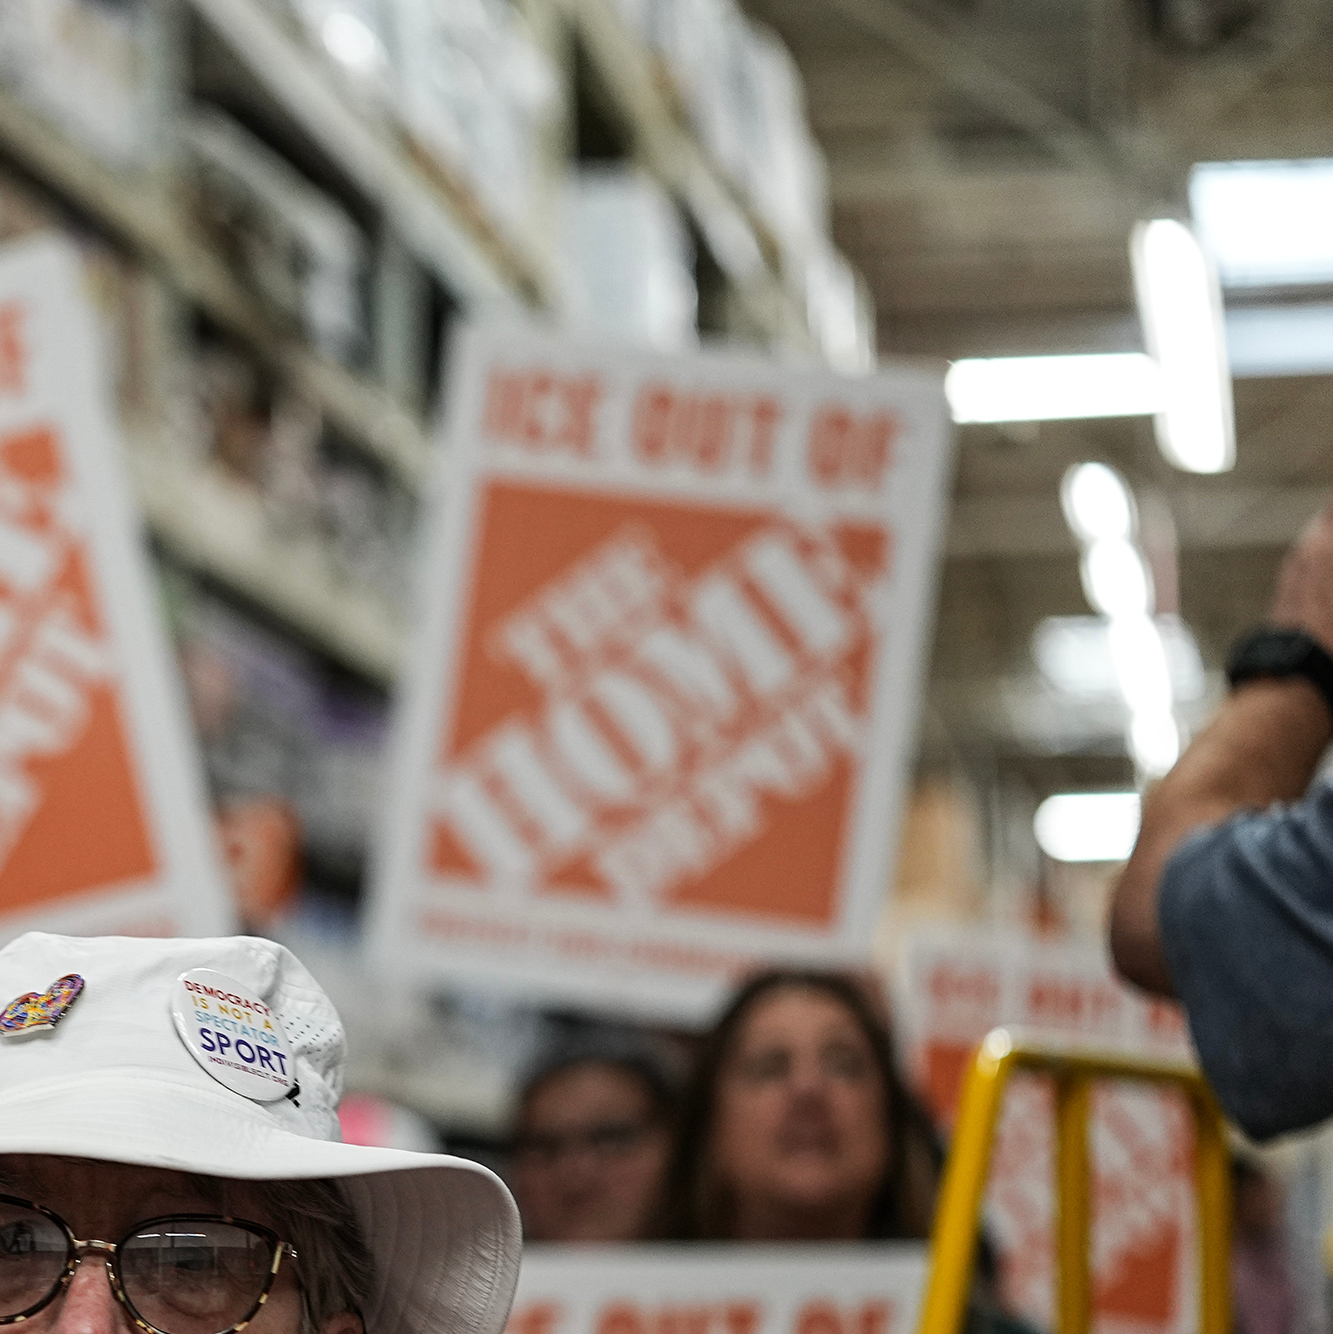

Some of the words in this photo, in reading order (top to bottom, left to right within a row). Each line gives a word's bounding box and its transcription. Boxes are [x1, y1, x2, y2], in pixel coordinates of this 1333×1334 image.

[183, 979, 271, 1017] DEMOCRACY
[191, 994, 210, 1010] IS
[217, 1003, 253, 1024] NOT
[263, 1018, 275, 1032] A
[194, 1009, 281, 1048] SPECTATOR
[199, 1027, 288, 1077] SPORT
